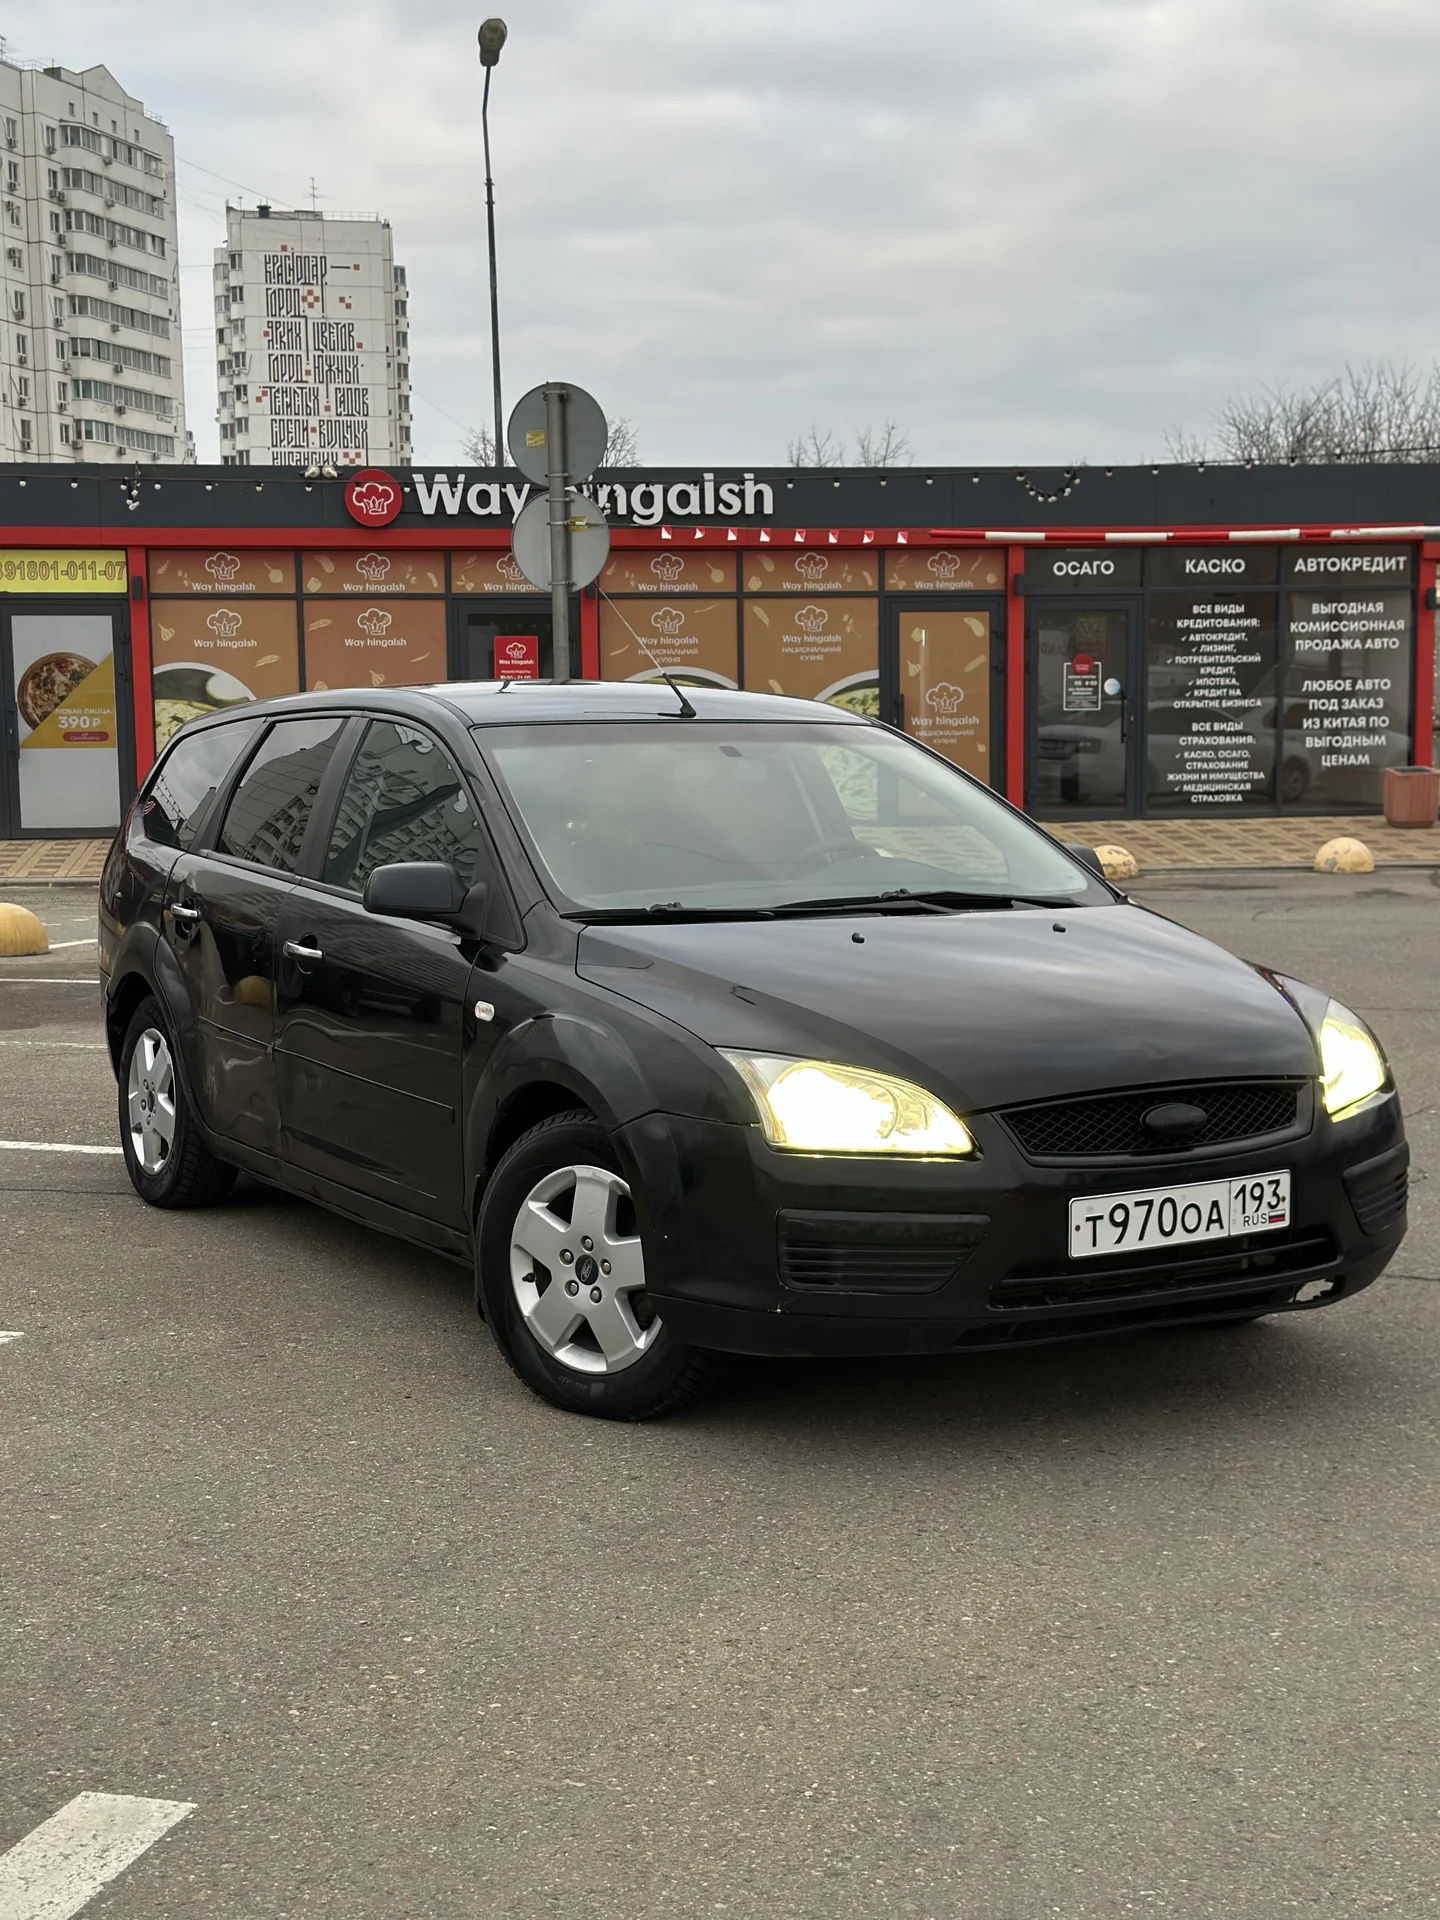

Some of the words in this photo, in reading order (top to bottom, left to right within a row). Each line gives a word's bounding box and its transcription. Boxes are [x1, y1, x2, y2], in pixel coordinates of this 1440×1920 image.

[265, 288, 306, 317] ГОРОД
[267, 320, 302, 350] ЯРКИХ
[312, 321, 355, 353] ЦВЕТОВ
[268, 353, 307, 383] ГОРОД
[313, 354, 359, 386] ЮЖНЫХ
[335, 387, 369, 417] САДОВ
[271, 419, 309, 448] СРЕДИ
[319, 419, 368, 450] ВОЛЬНЫХ
[412, 473, 530, 524] Way
[1053, 560, 1115, 576] ОСАГО
[1185, 558, 1246, 573] КАСКО
[1294, 556, 1407, 573] АВТОКРЕДИТ
[192, 582, 213, 593] Way
[215, 581, 256, 593] hingalsh
[343, 582, 364, 593] Way
[366, 581, 405, 593] hingalsh
[483, 582, 504, 592] Way
[638, 582, 658, 592] Way
[660, 581, 698, 592] hingalsh
[782, 582, 802, 592] Way
[803, 581, 841, 592] hingalsh
[915, 580, 934, 590] Way
[935, 580, 974, 590] hingalsh
[1192, 604, 1213, 614] ВСЕ
[1213, 604, 1245, 615] ВИДЫ
[1311, 602, 1384, 615] ВЫГОДНАЯ
[1176, 618, 1261, 629] КРЕДИТОВАНИЯ:
[1290, 619, 1405, 633] КОМИССИОННАЯ
[344, 638, 365, 648] Way
[367, 637, 406, 648] hingalsh
[660, 635, 698, 647] hingalsh
[782, 634, 802, 644] Way
[803, 634, 842, 644] hingalsh
[1188, 632, 1248, 642] АВТОКРЕДИТ,
[194, 639, 215, 649] Way
[216, 639, 257, 649] hingalsh
[1199, 643, 1237, 653] ЛИЗИНГ,
[1295, 638, 1362, 652] ПРОДАЖА
[1364, 637, 1400, 650] АВТО
[1175, 652, 1261, 664] ПОТРЕБИТЕЛЬСКИЙ
[1301, 679, 1353, 692] ЛЮБОЕ
[1355, 678, 1391, 691] АВТО
[1193, 688, 1228, 697] КРЕДИТ
[1229, 688, 1242, 696] НА
[1173, 699, 1220, 709] ОТКРЫТИЕ
[1221, 698, 1262, 708] БИЗНЕСА
[1308, 698, 1339, 712] ПОД
[1341, 697, 1384, 710] ЗАКАЗ
[58, 716, 90, 729] 390
[911, 716, 934, 728] Way
[935, 715, 979, 728] hingalsh
[1191, 722, 1212, 732] ВСЕ
[1213, 721, 1244, 732] ВИДЫ
[1302, 717, 1321, 729] ИЗ
[1323, 716, 1367, 728] КИТАЯ
[1368, 715, 1390, 727] ПО
[1179, 735, 1256, 746] СТРАХОВАНИЯ:
[1305, 735, 1387, 748] ВЫГОДНЫМ
[1185, 761, 1249, 770] СТРАХОВАНИЕ
[1321, 754, 1370, 767] ЦЕНАМ
[1167, 772, 1200, 781] ЖИЗНИ
[1201, 772, 1208, 781] И
[1209, 771, 1266, 781] ИМУЩЕСТВА
[1182, 782, 1252, 793] МЕДИЦИНСКАЯ
[1191, 794, 1243, 803] СТРАХОВКА
[1234, 1179, 1281, 1215] 193
[1243, 1212, 1268, 1227] RUS
